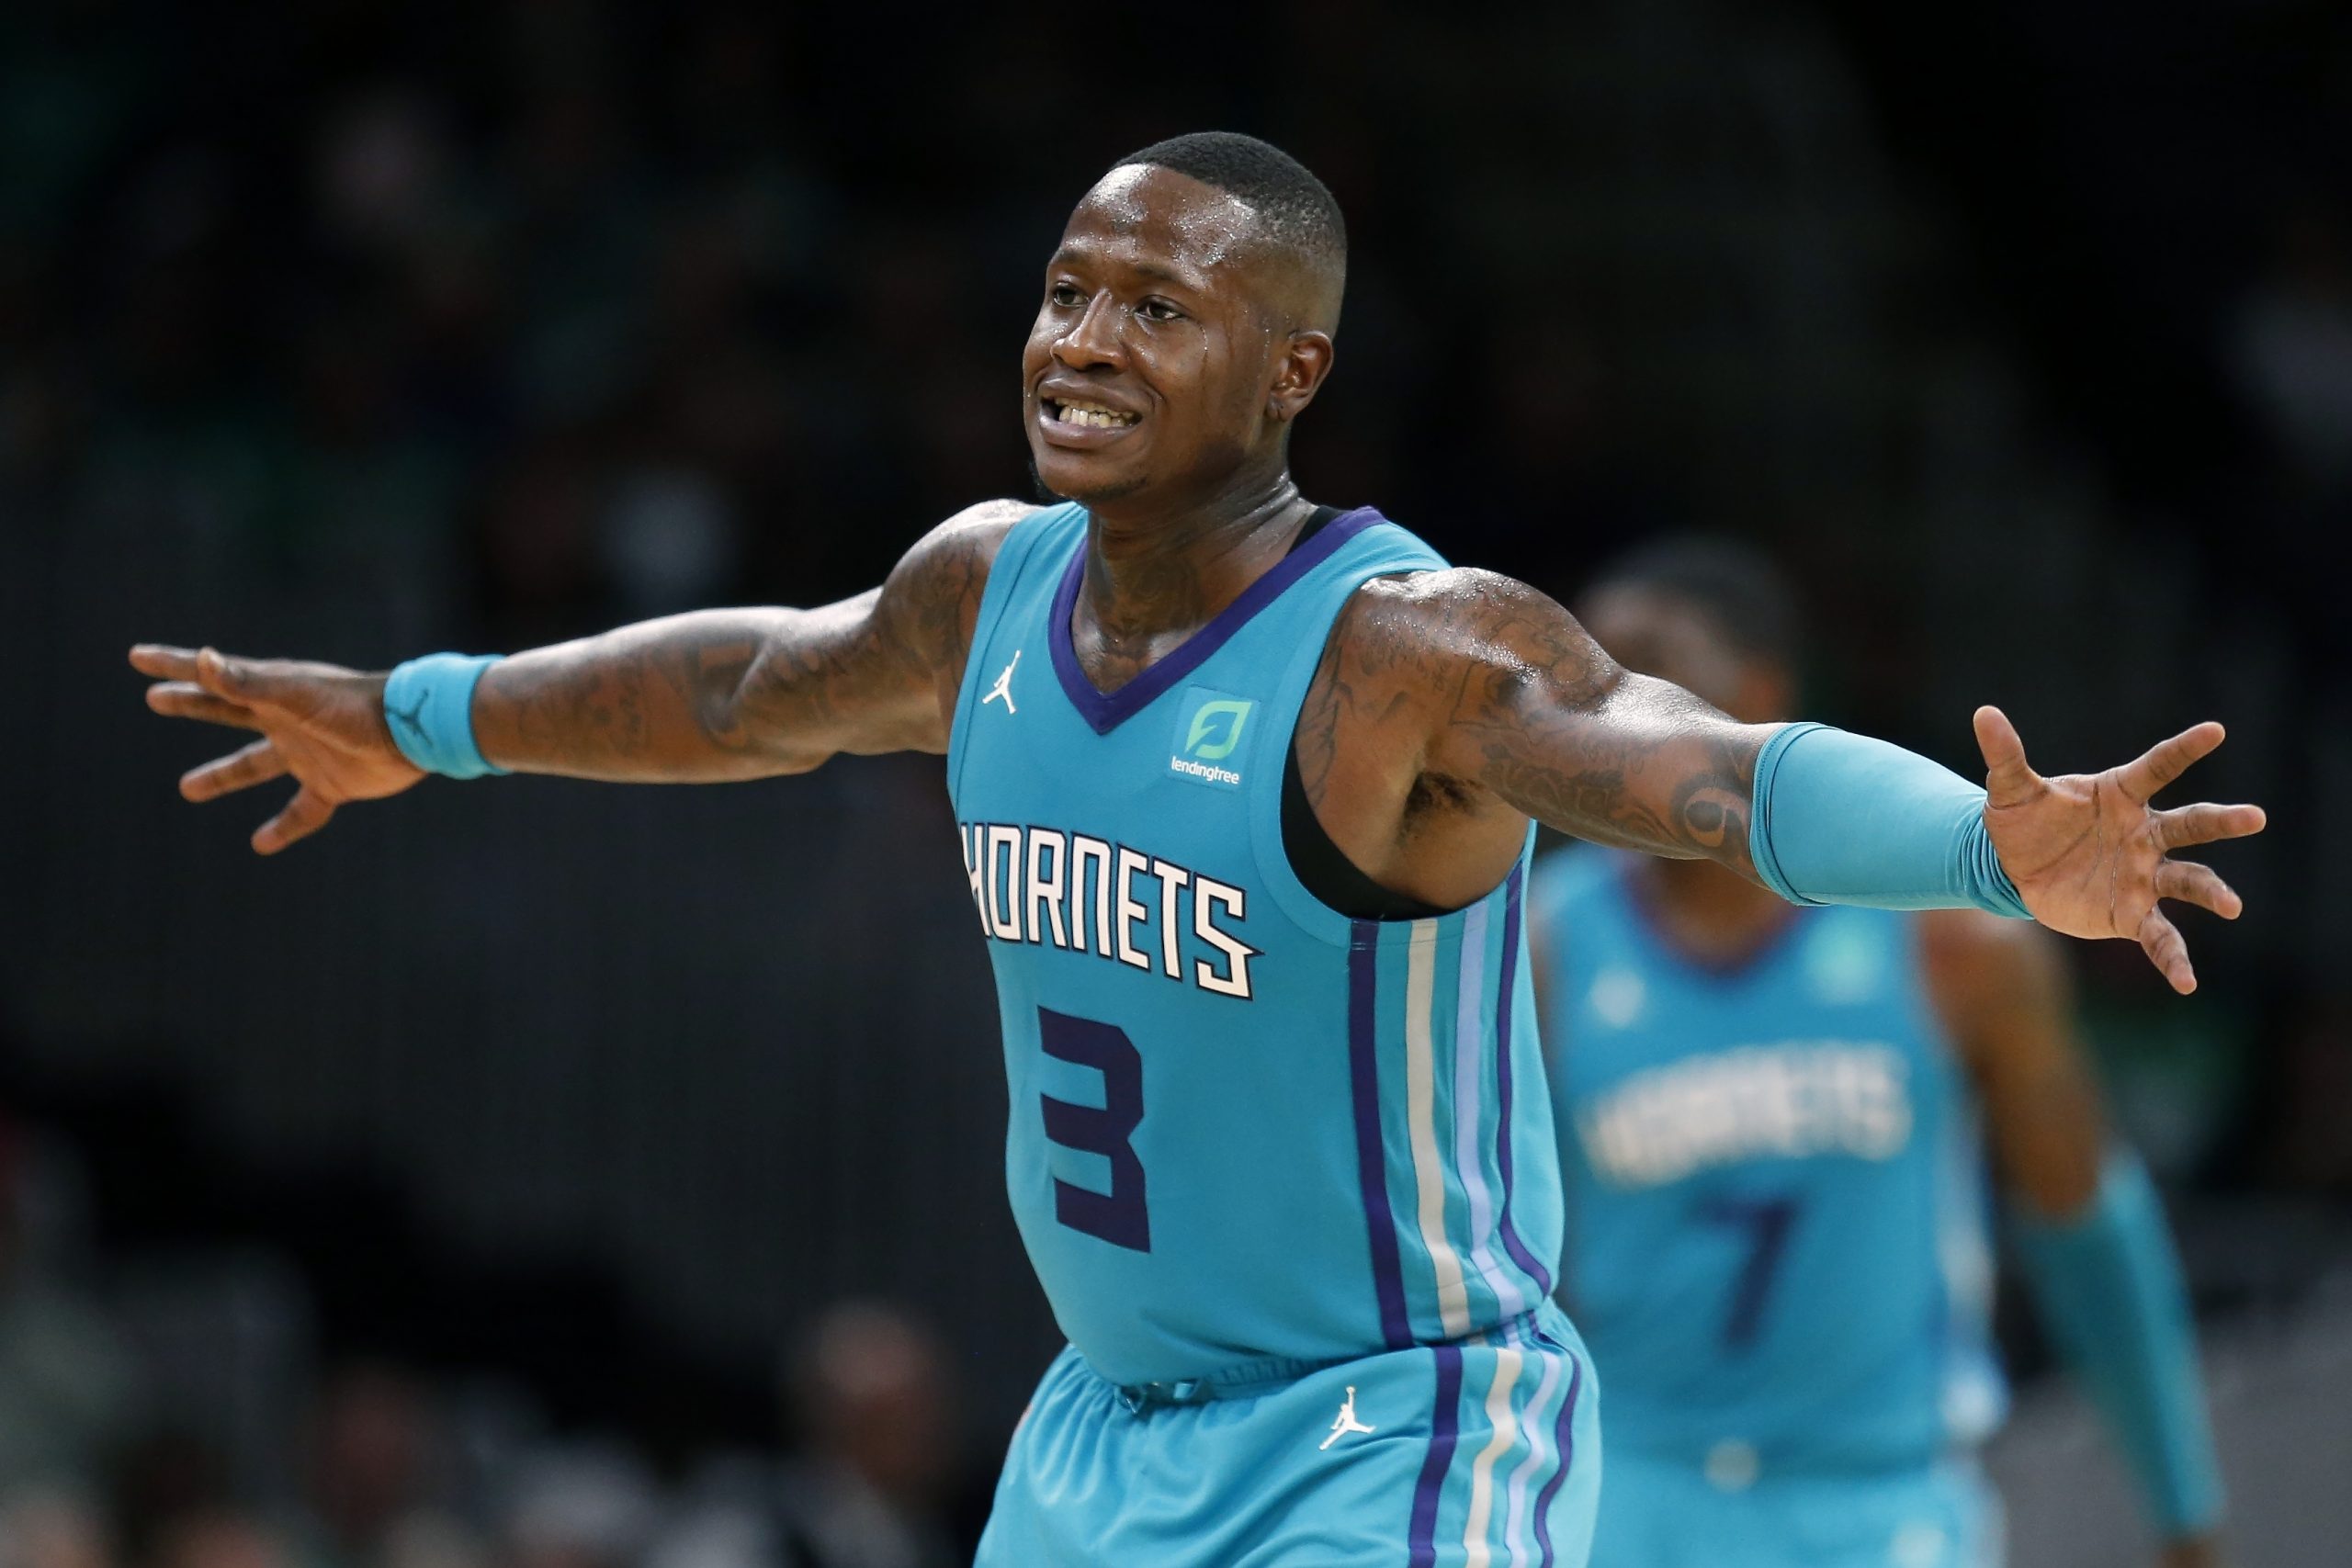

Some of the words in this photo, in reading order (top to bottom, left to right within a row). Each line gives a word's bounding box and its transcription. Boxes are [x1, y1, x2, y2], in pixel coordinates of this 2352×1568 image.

[1170, 755, 1239, 784] lendingtree
[1036, 1004, 1151, 1255] 3
[1687, 1194, 1801, 1355] 7
